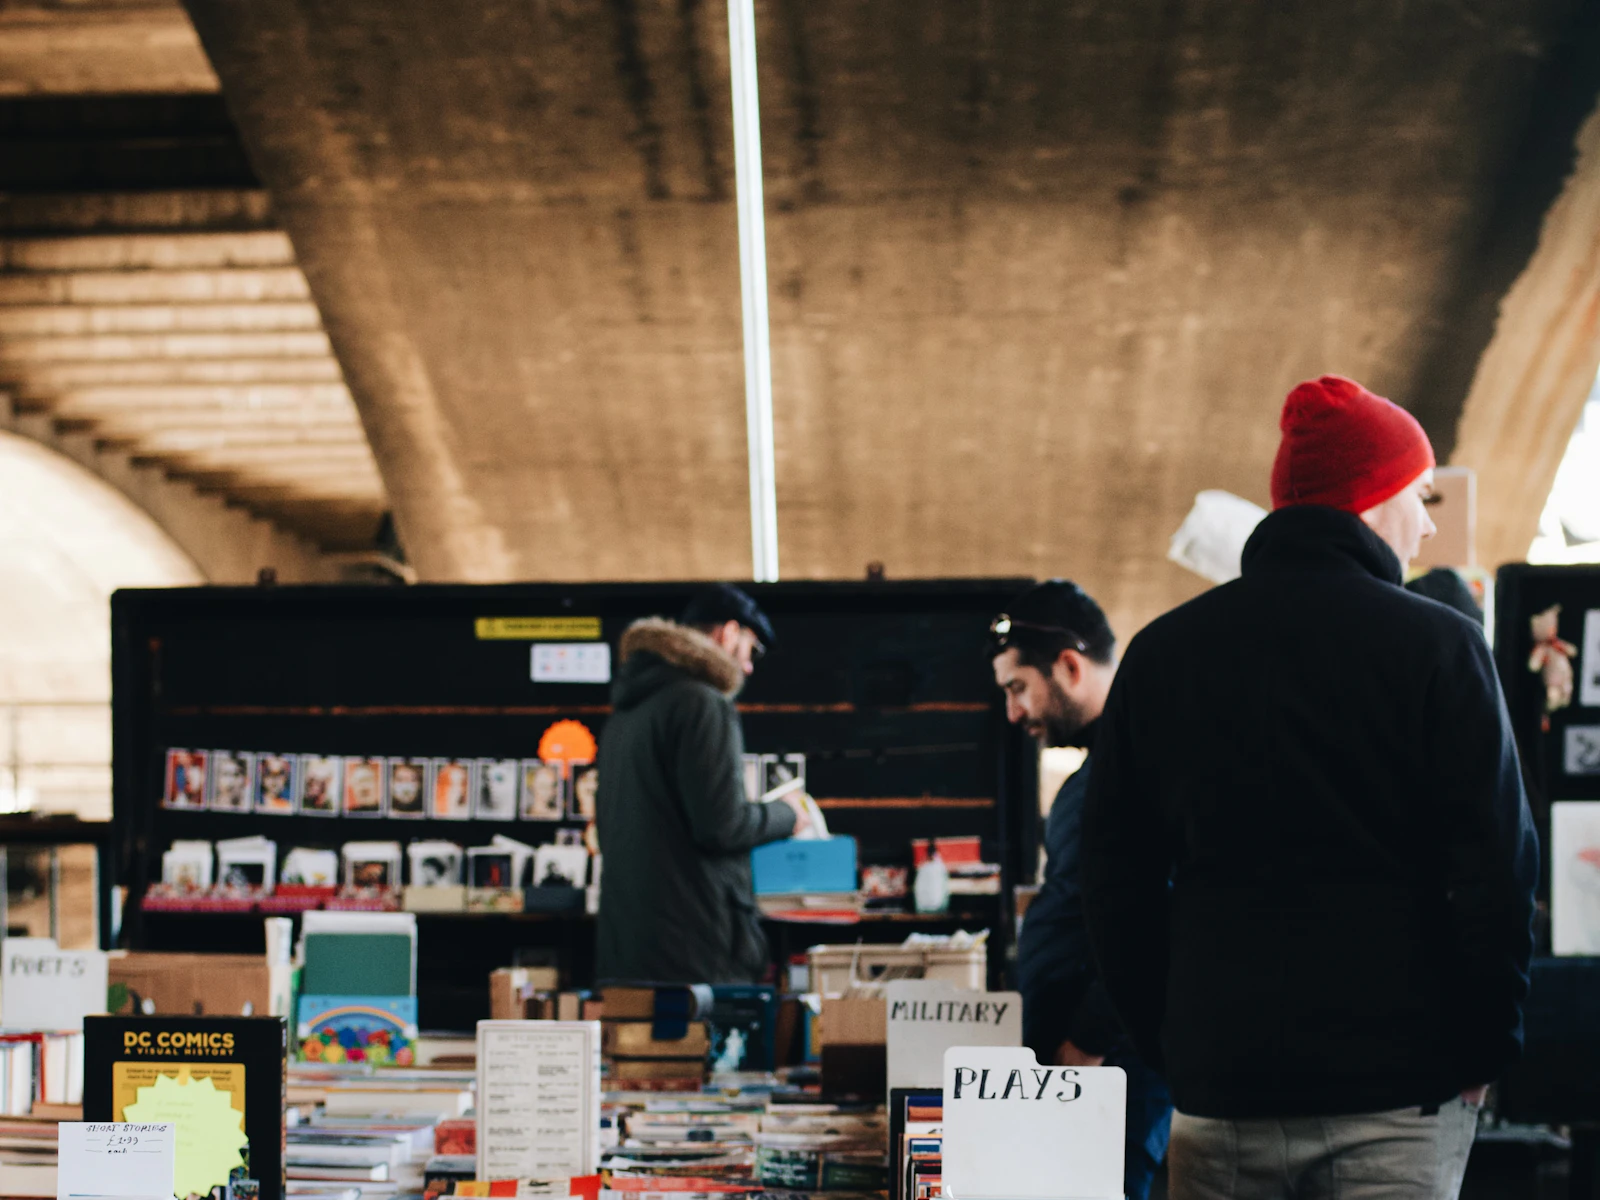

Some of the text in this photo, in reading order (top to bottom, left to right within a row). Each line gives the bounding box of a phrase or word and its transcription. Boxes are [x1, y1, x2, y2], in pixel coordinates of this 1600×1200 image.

[10, 953, 87, 978] POETS
[891, 1001, 1009, 1026] MILITARY
[124, 1031, 235, 1049] DC COMICS
[136, 1048, 179, 1056] VISUAL
[184, 1048, 235, 1056] HISTORY
[953, 1067, 1082, 1102] PLAYS
[86, 1124, 167, 1132] SHORT STORIES
